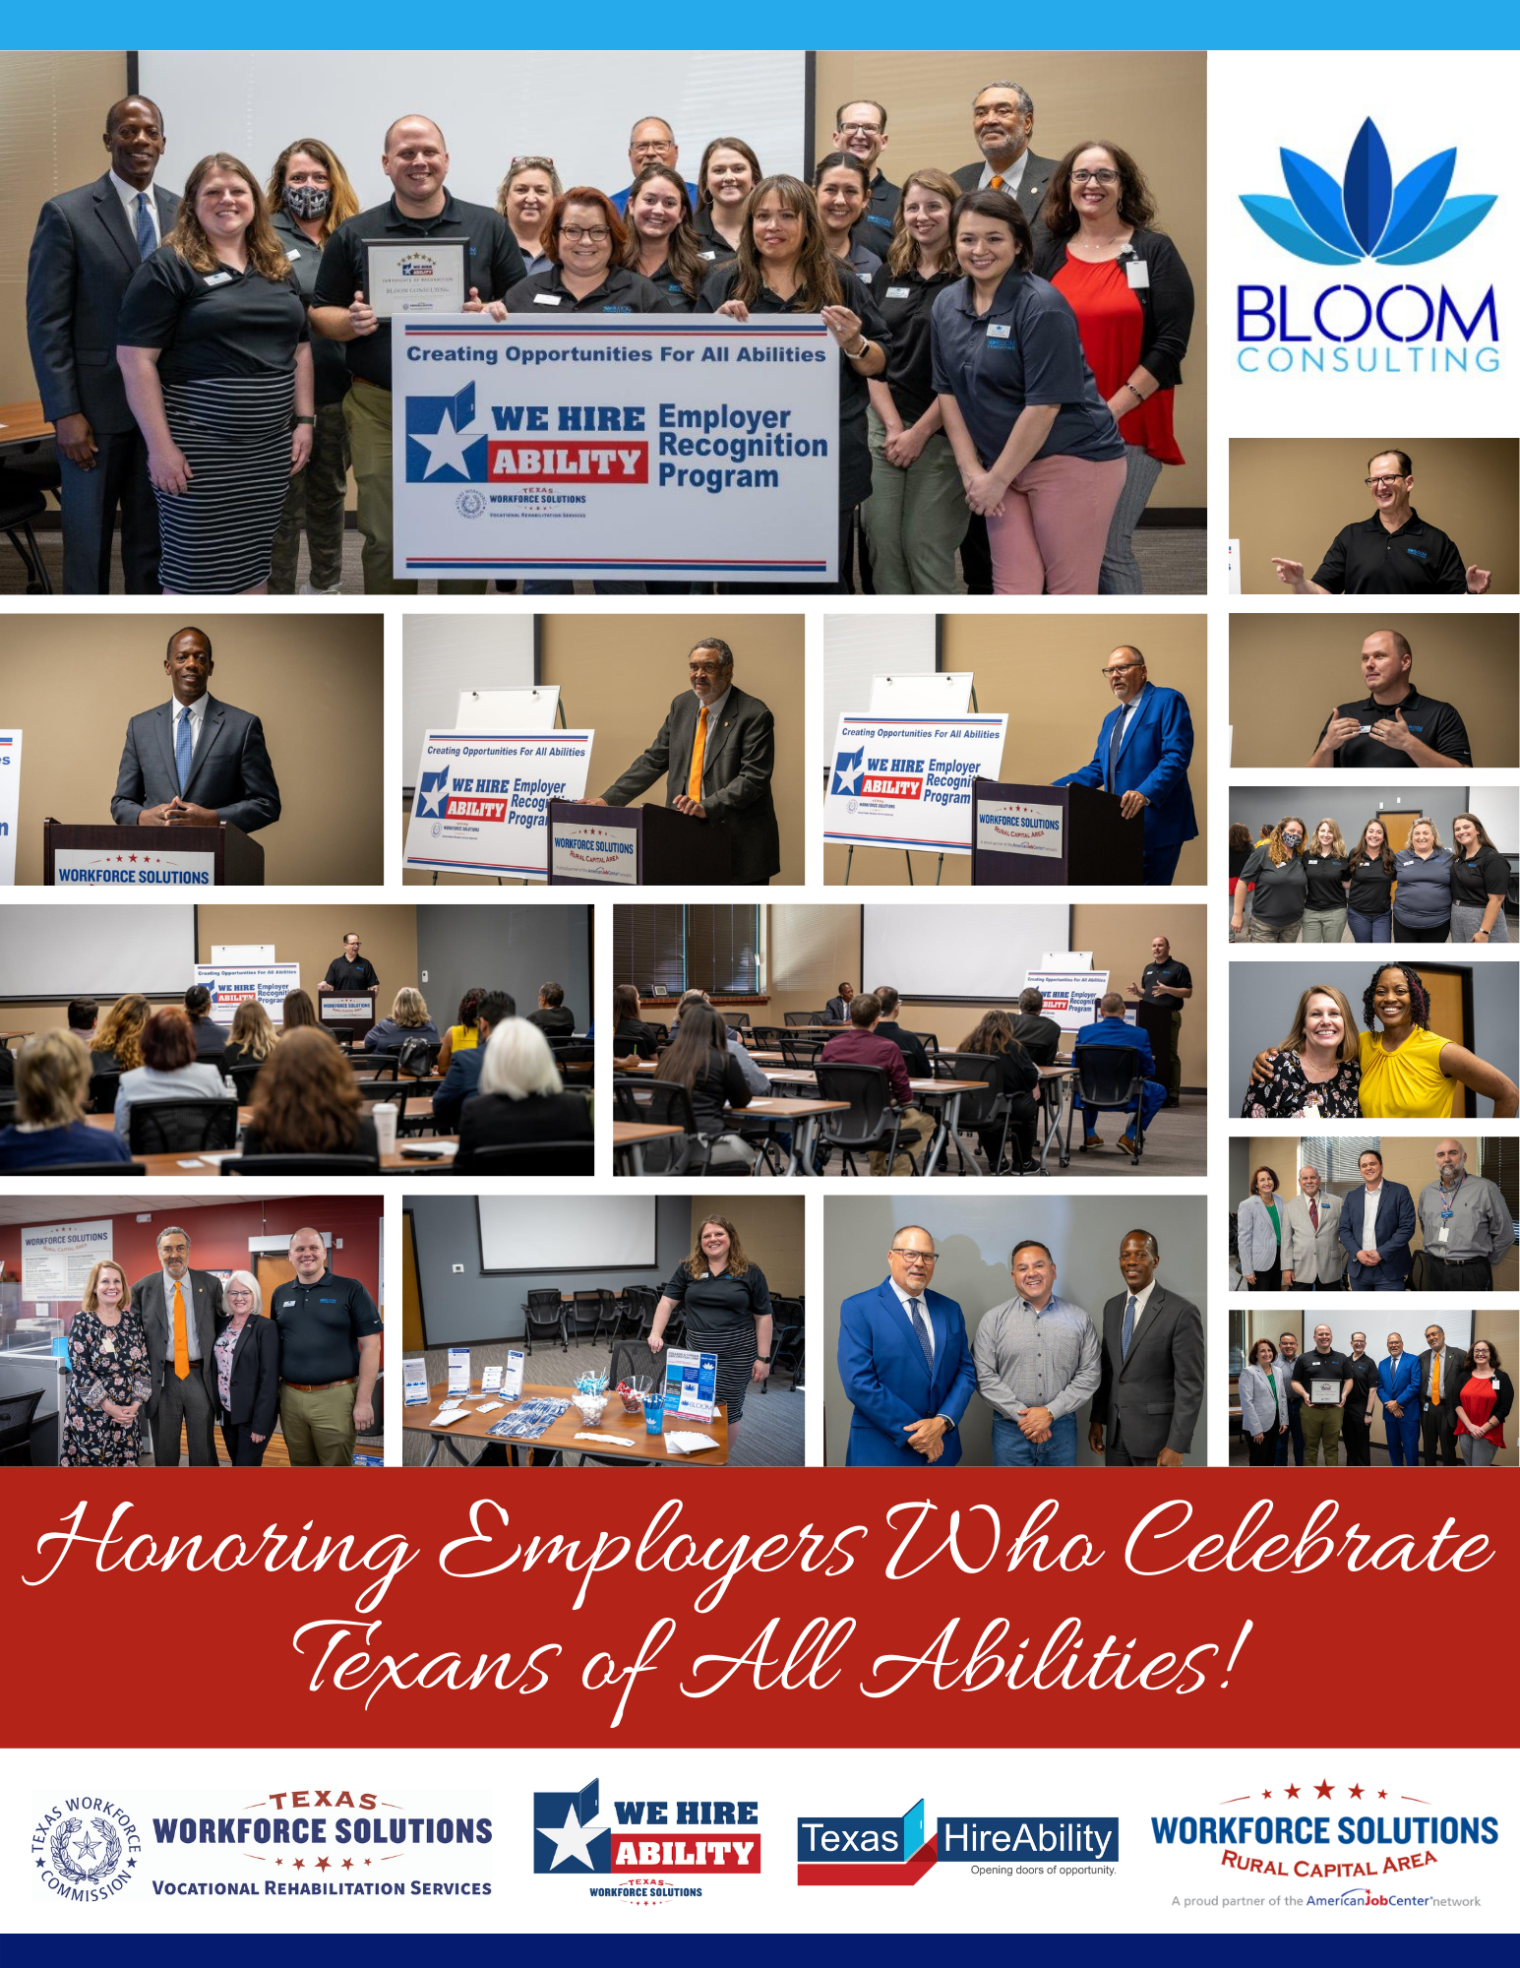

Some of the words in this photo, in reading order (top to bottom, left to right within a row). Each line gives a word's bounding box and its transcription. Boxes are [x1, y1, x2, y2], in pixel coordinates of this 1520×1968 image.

[407, 346, 498, 364] Creating
[506, 346, 653, 365] Opportunities
[660, 346, 694, 362] For
[701, 346, 728, 362] All
[736, 346, 826, 362] Abilities
[491, 406, 548, 431] WE
[558, 406, 646, 432] HIRE
[659, 403, 791, 434] Employer
[659, 432, 828, 463] Recognition
[493, 450, 642, 475] ABILITY
[659, 462, 779, 494] Program
[490, 494, 539, 504] WORKFORCE
[541, 494, 586, 504] SOLUTIONS
[842, 728, 875, 738] Creating
[877, 728, 932, 738] Opportunities
[934, 730, 948, 738] For
[950, 730, 962, 738] All
[964, 730, 1000, 739] Abilities
[428, 746, 460, 757] Creating
[462, 746, 518, 757] Opportunities
[520, 747, 533, 756] For
[535, 747, 548, 756] All
[550, 748, 586, 757] Abilities
[867, 758, 888, 772] WE
[890, 759, 925, 773] HIRE
[928, 758, 981, 776] Employer
[452, 778, 474, 792] WE
[476, 779, 510, 794] HIRE
[513, 778, 566, 796] Employer
[862, 777, 920, 794] ABILITY
[923, 789, 971, 806] Program
[447, 801, 504, 818] ABILITY
[508, 810, 548, 829] Progra
[979, 814, 1020, 827] WORKFORCE
[1020, 816, 1060, 830] SOLUTIONS
[994, 826, 1010, 836] RURAL
[554, 836, 594, 851] WORKFORCE
[596, 840, 634, 854] SOLUTIONS
[570, 850, 586, 862] RURAL
[58, 868, 136, 883] WORKFORCE
[138, 871, 209, 884] SOLUTIONS
[257, 982, 288, 991] Employer
[1070, 990, 1096, 1000] Employer
[1042, 1000, 1067, 1008] BILITY
[1068, 1004, 1092, 1013] Program
[26, 1236, 66, 1246] WORKFORCE
[67, 1232, 108, 1243] SOLUTIONS
